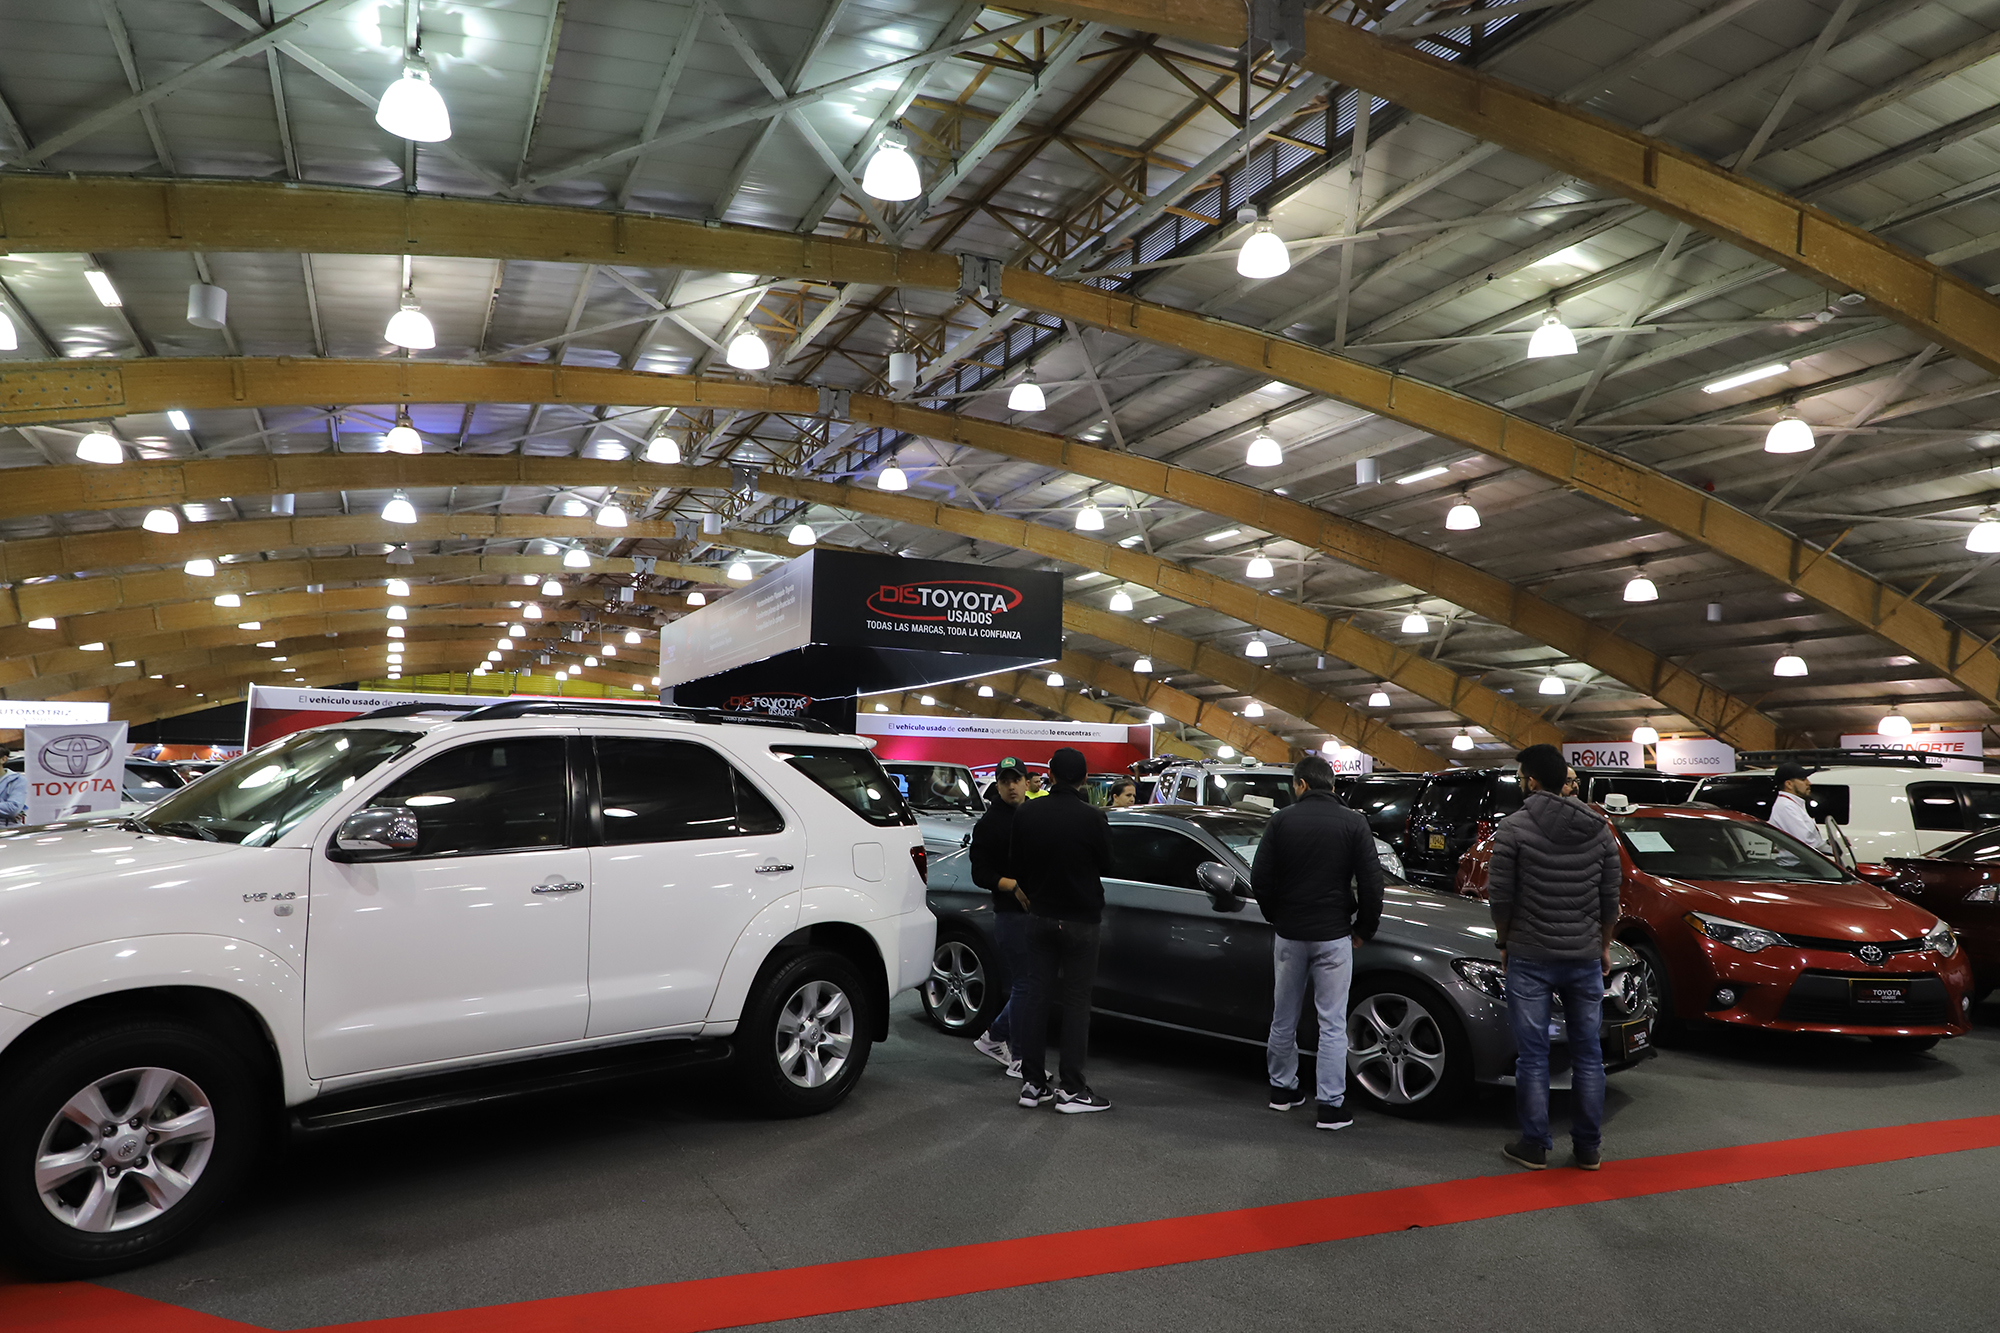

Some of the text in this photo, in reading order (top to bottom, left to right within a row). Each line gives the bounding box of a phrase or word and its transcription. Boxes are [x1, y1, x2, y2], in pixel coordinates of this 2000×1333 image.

[879, 585, 1008, 612] DISTOYOTA
[947, 610, 993, 625] USADOS
[866, 620, 1022, 640] TODAS LAS MARCAS, TODA LA CONFIANZA
[298, 695, 308, 703] El
[309, 695, 351, 705] vehículo
[352, 697, 381, 706] usado
[382, 698, 393, 707] de
[896, 723, 926, 731] vehículo
[1020, 728, 1049, 736] buscando
[1673, 757, 1720, 765] LOS USADOS
[31, 778, 116, 797] TOYOTA
